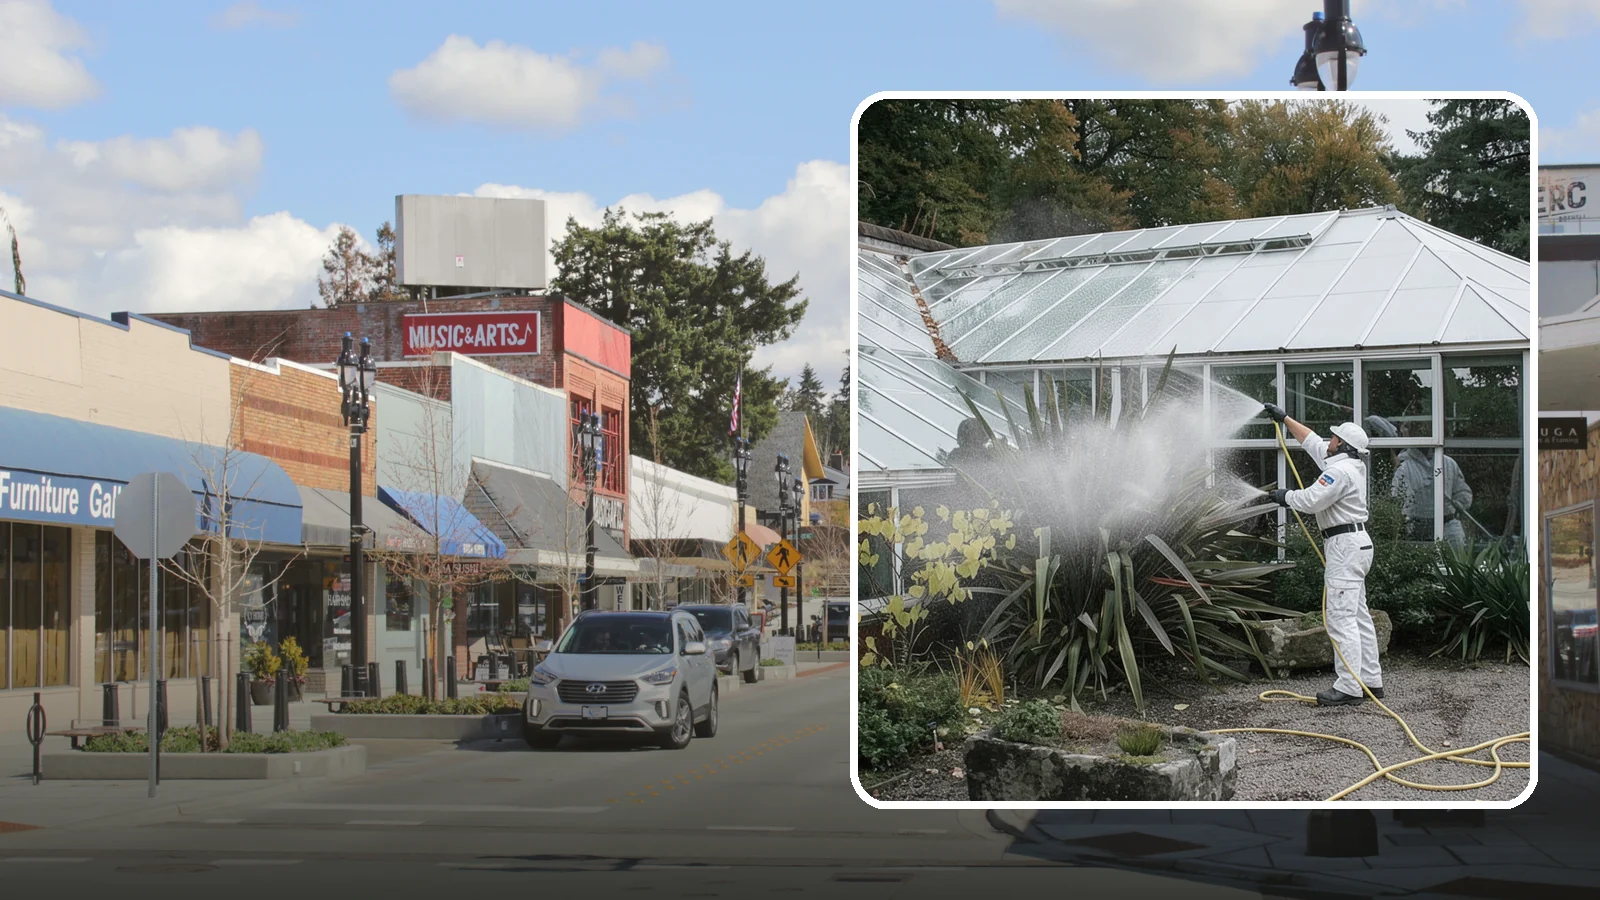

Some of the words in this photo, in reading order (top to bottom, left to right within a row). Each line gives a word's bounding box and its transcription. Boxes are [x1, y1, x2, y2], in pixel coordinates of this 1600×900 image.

[408, 323, 520, 349] MUSIC&ARTS
[1540, 428, 1578, 437] UGA
[0, 471, 79, 515] Furniture
[89, 482, 121, 519] Gal
[453, 563, 479, 574] SUSHI
